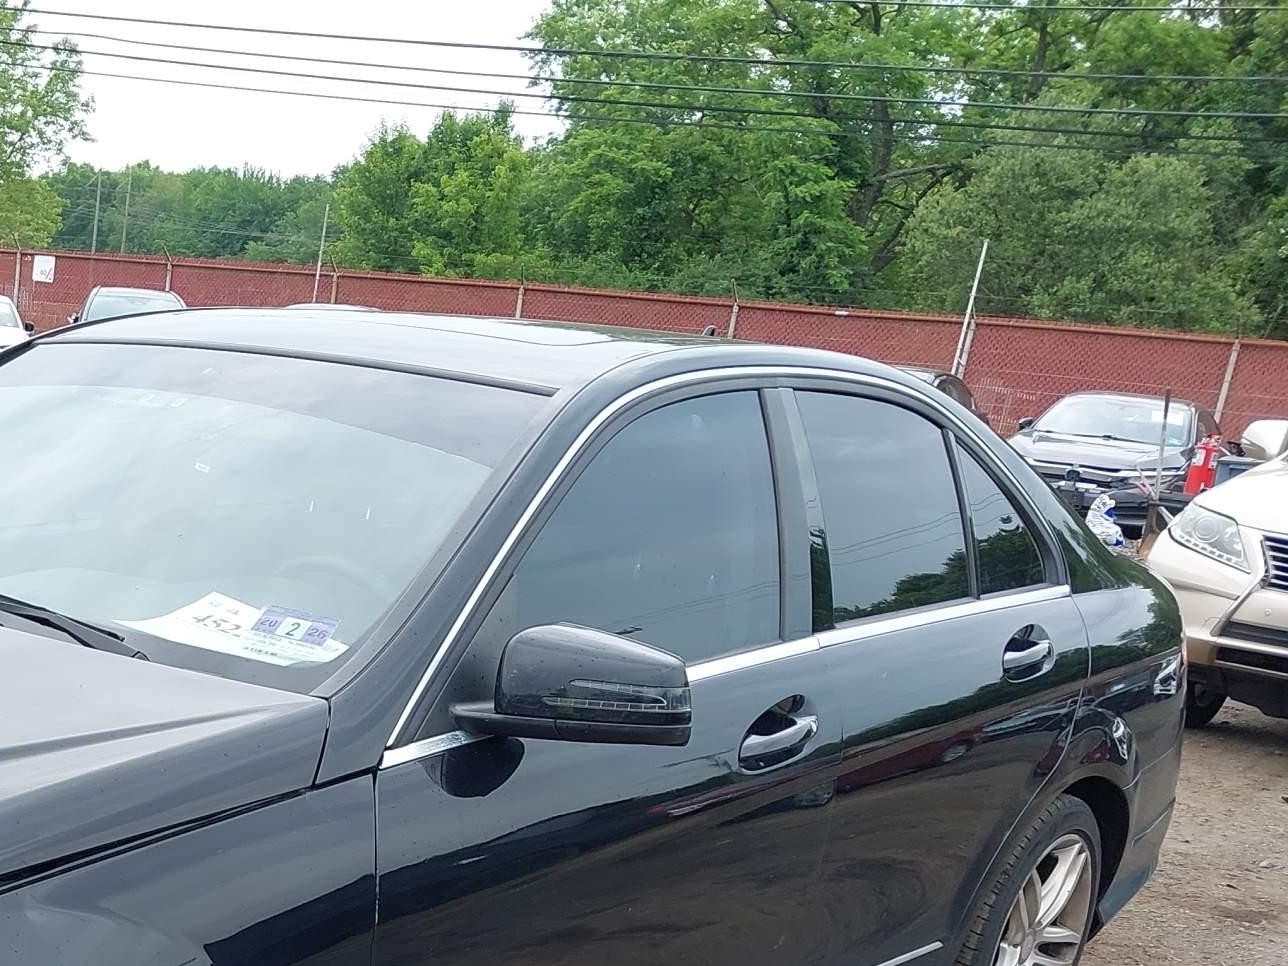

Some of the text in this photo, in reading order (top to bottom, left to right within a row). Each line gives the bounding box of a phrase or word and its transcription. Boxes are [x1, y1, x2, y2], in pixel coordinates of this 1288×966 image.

[260, 616, 329, 640] 20 2 26
